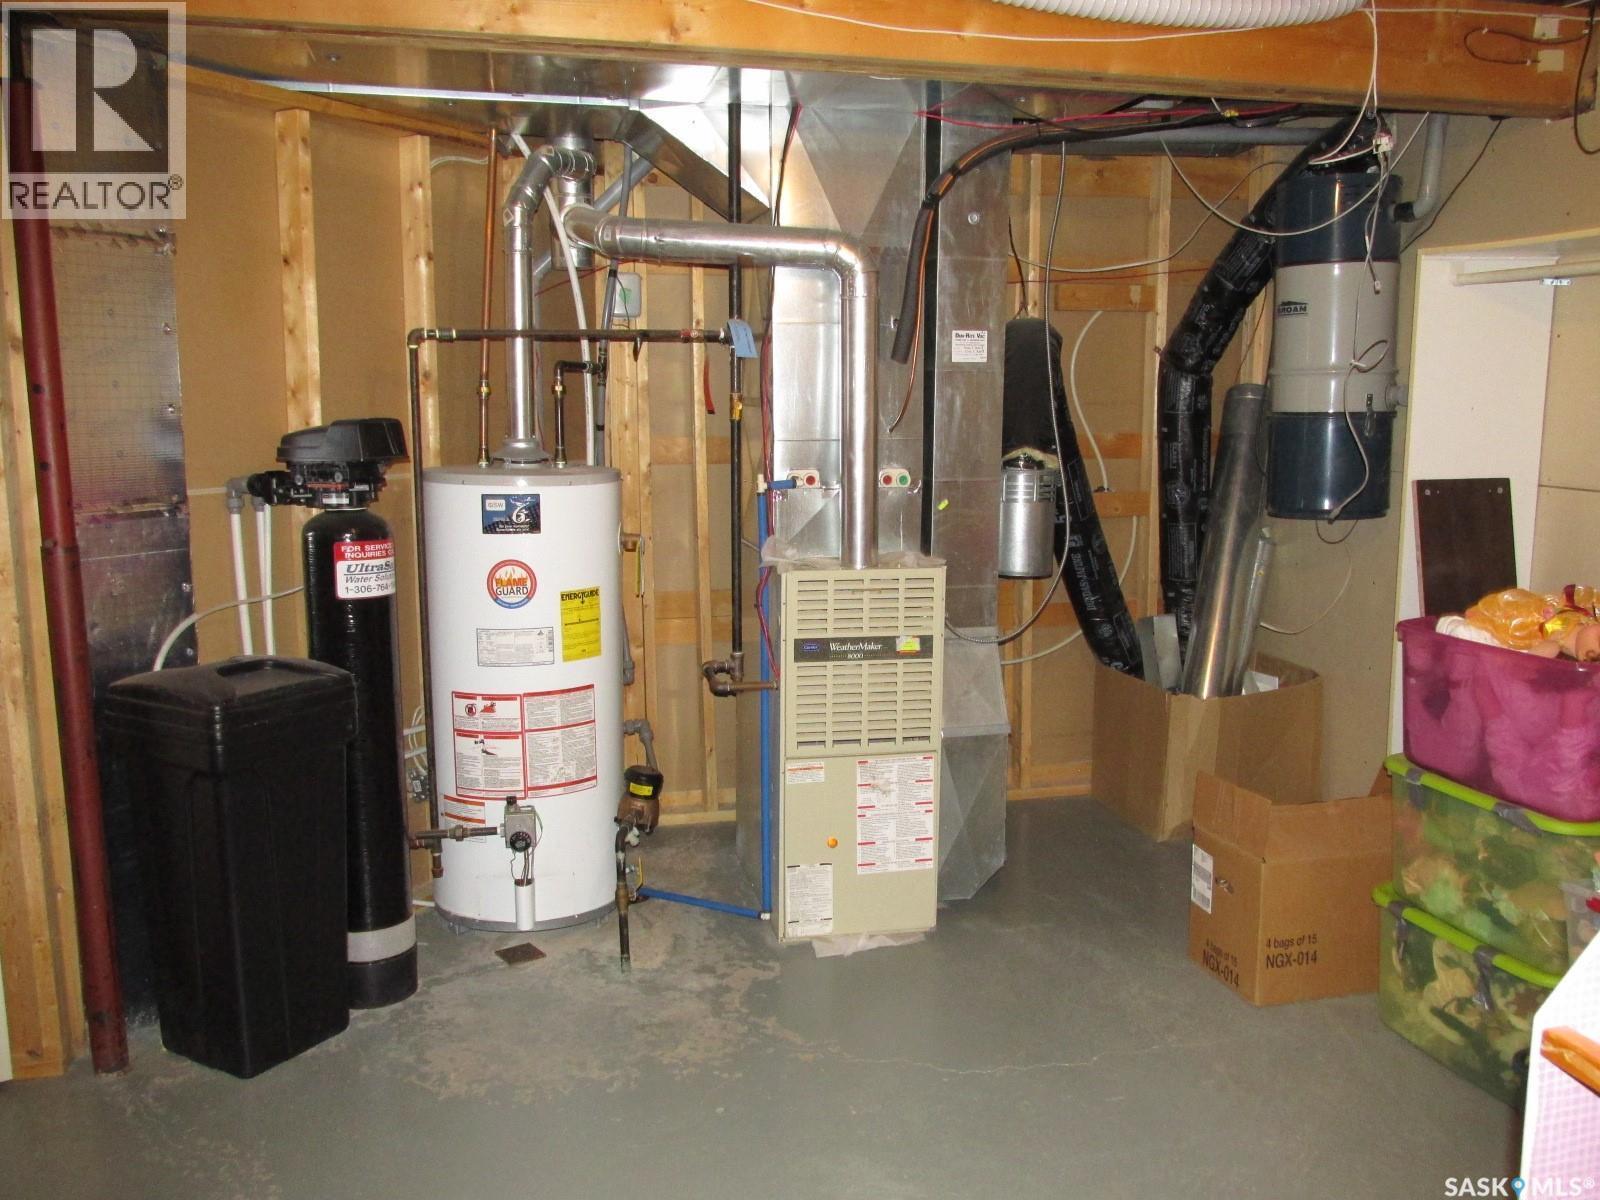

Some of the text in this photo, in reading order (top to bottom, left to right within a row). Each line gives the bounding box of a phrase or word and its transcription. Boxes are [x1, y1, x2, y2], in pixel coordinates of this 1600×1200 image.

[341, 545, 361, 553] FOR
[344, 550, 387, 559] INQUIRIES
[346, 560, 394, 573] UltraS
[345, 575, 374, 584] Water
[495, 577, 528, 587] FLAME
[495, 586, 529, 596] GUARD
[829, 641, 882, 651] WeatherMaker
[1273, 937, 1295, 950] bags
[1296, 934, 1306, 946] of
[1307, 933, 1318, 945] 15
[1266, 950, 1318, 969] NGX-014
[1202, 948, 1240, 988] NGX-014
